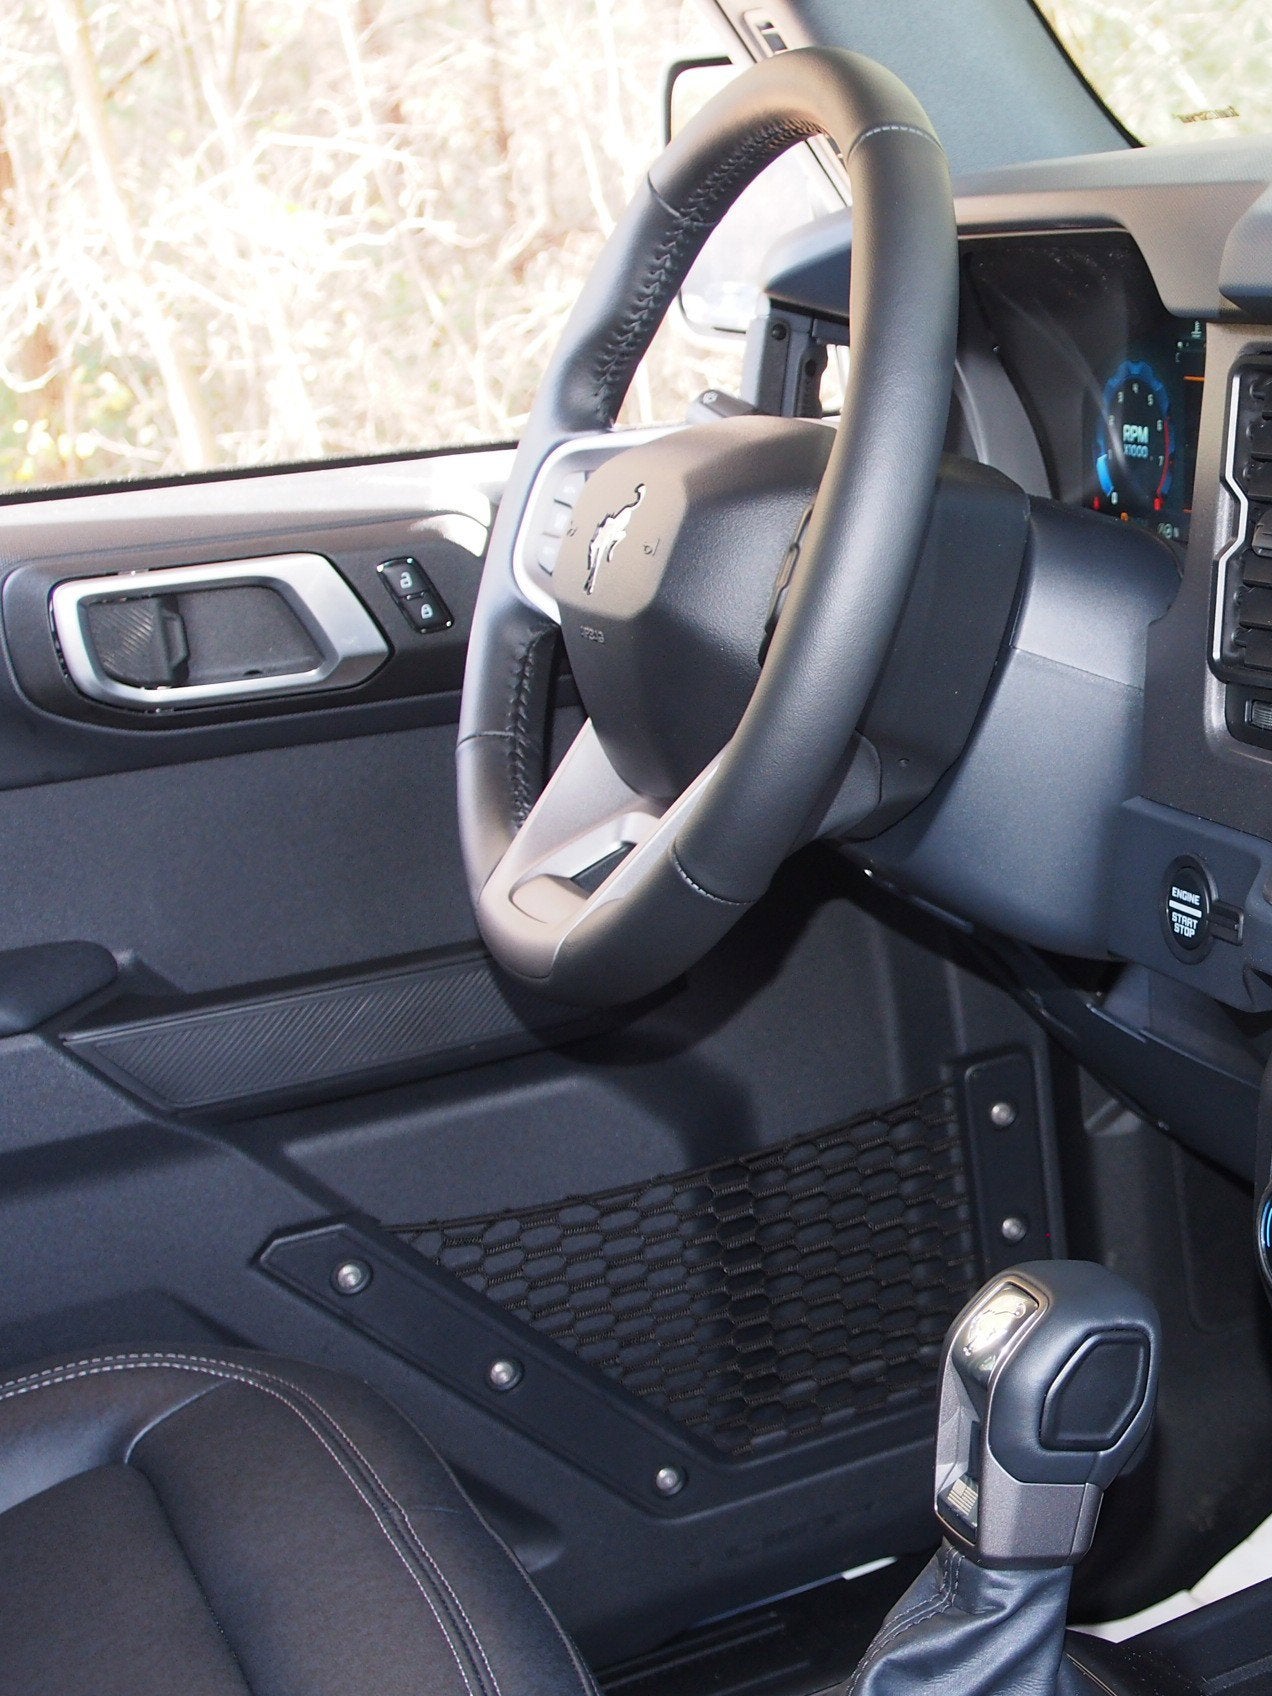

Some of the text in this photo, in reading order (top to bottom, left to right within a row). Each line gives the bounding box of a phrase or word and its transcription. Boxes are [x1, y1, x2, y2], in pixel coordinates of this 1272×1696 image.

[1122, 424, 1149, 444] RPM
[1171, 886, 1200, 906] ENGINE
[1171, 911, 1199, 930] START
[1173, 922, 1196, 938] STOP
